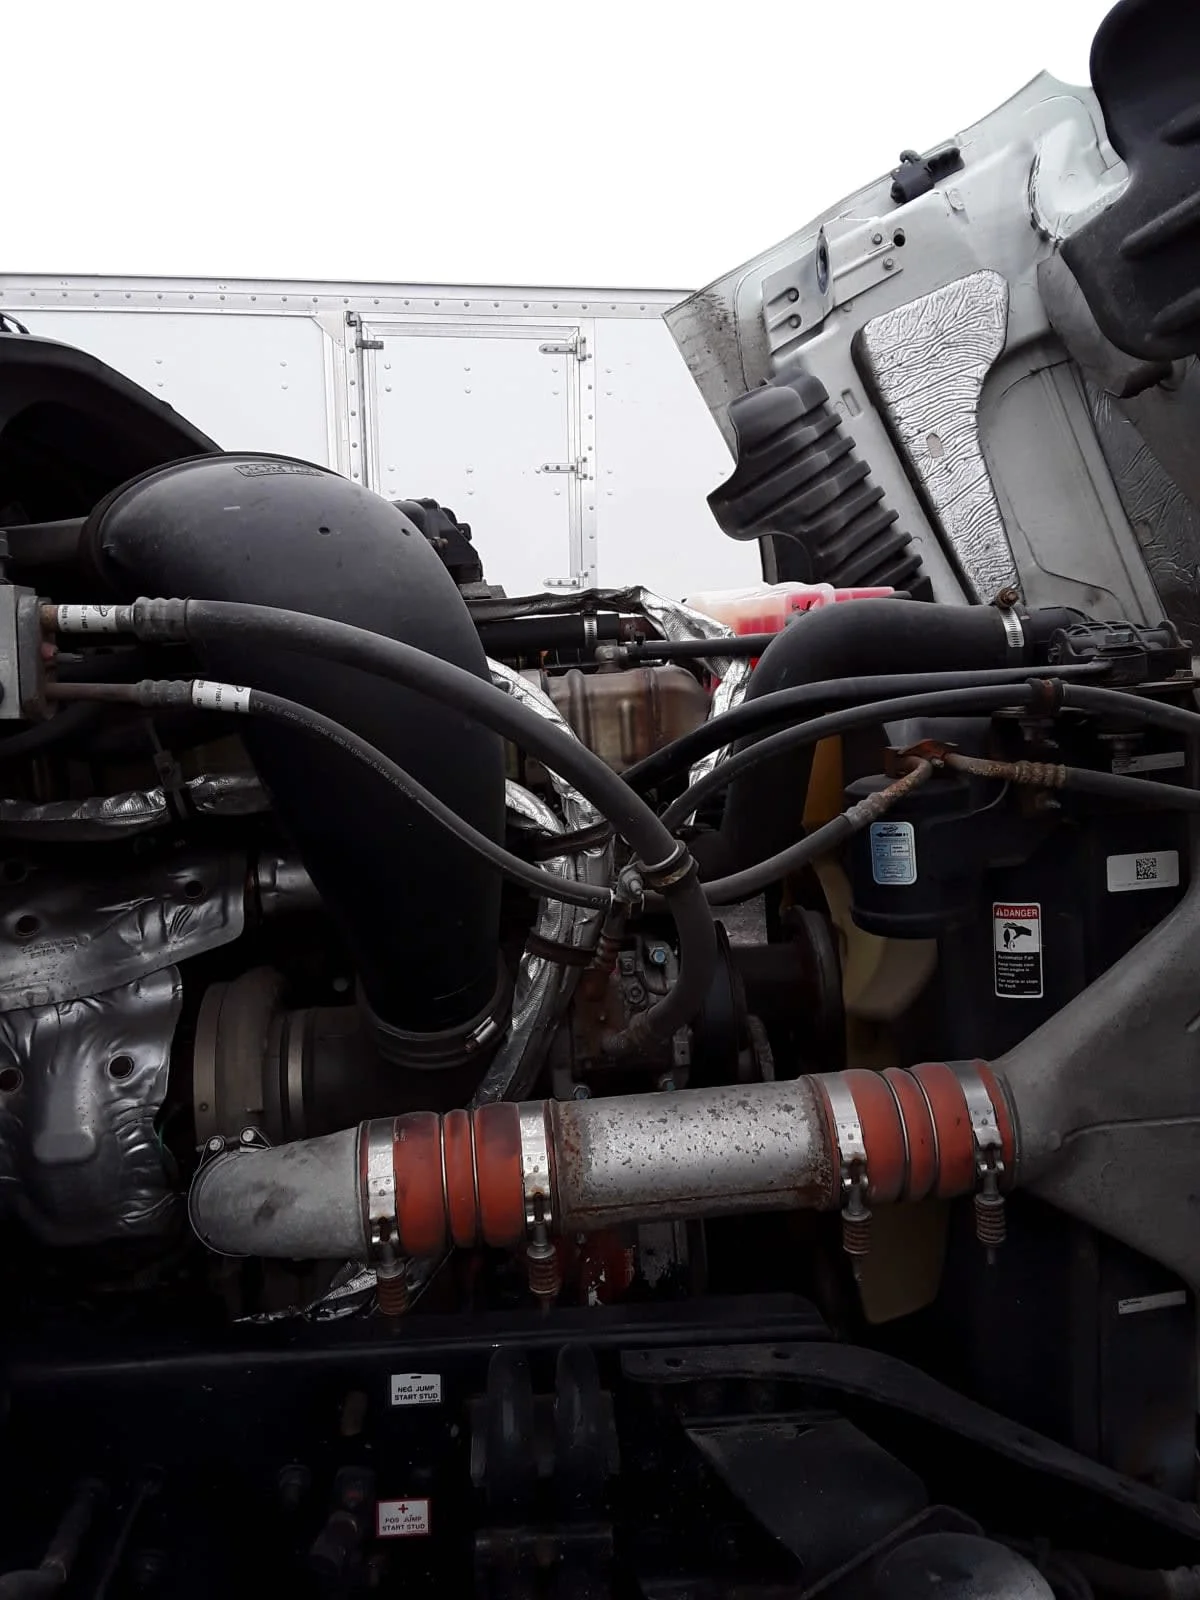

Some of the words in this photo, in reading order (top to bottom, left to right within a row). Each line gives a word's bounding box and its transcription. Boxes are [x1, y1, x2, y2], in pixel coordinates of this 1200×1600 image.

[1003, 908, 1038, 917] DANGER
[397, 1385, 413, 1393] NEG
[394, 1393, 417, 1401] START
[419, 1392, 438, 1400] STUD
[382, 1524, 405, 1532] START
[406, 1523, 426, 1531] STUD
